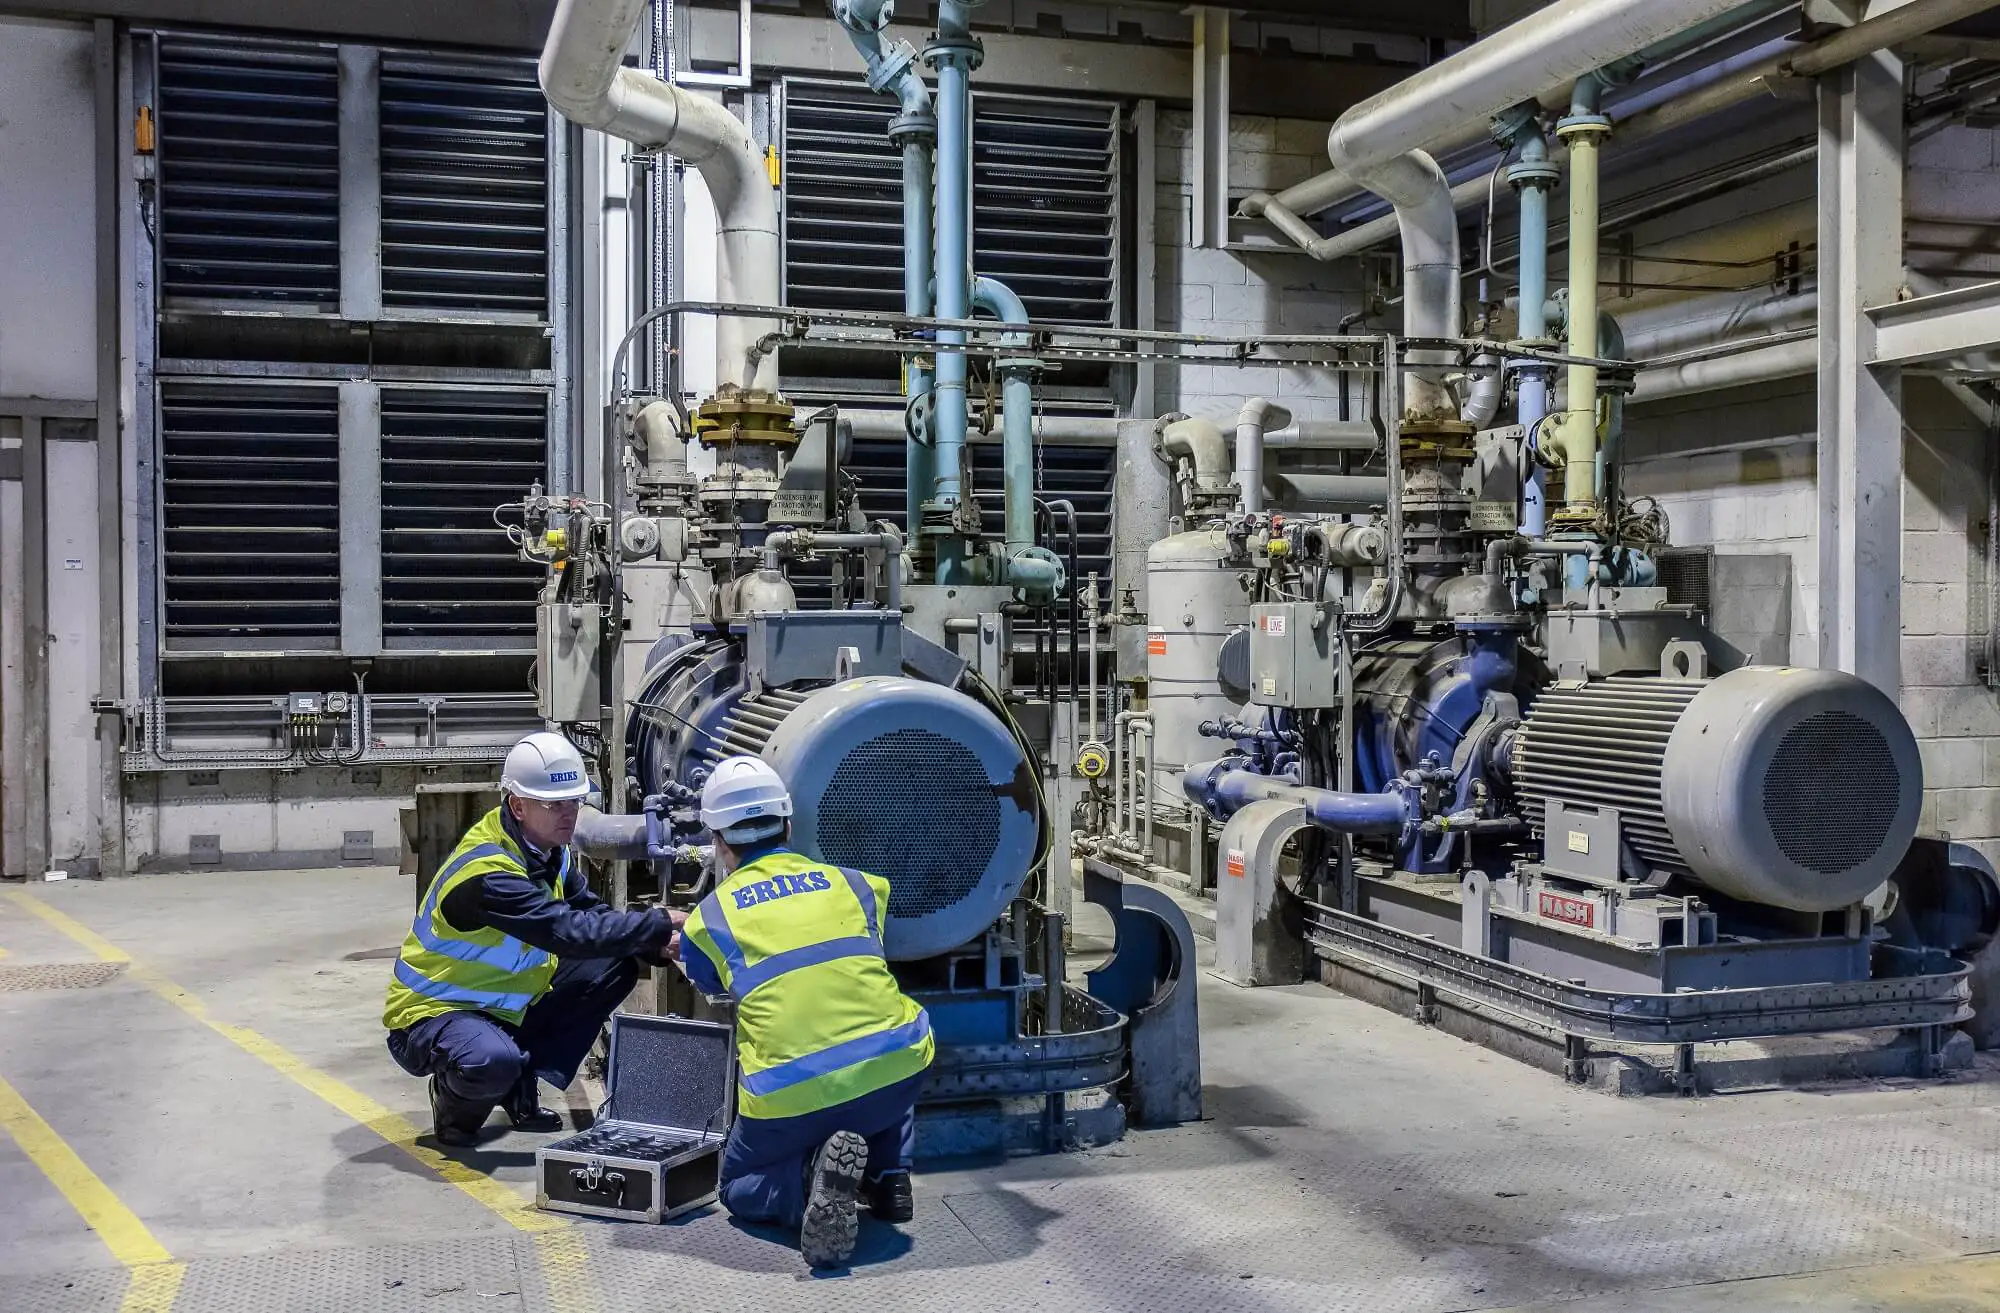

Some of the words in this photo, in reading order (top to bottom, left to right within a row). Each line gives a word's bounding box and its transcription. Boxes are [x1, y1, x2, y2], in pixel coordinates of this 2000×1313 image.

[1270, 620, 1283, 631] LIVE
[550, 770, 578, 783] ERIKS
[1228, 854, 1244, 864] NASH
[731, 871, 831, 910] ERIKS
[1542, 895, 1588, 923] NASH
